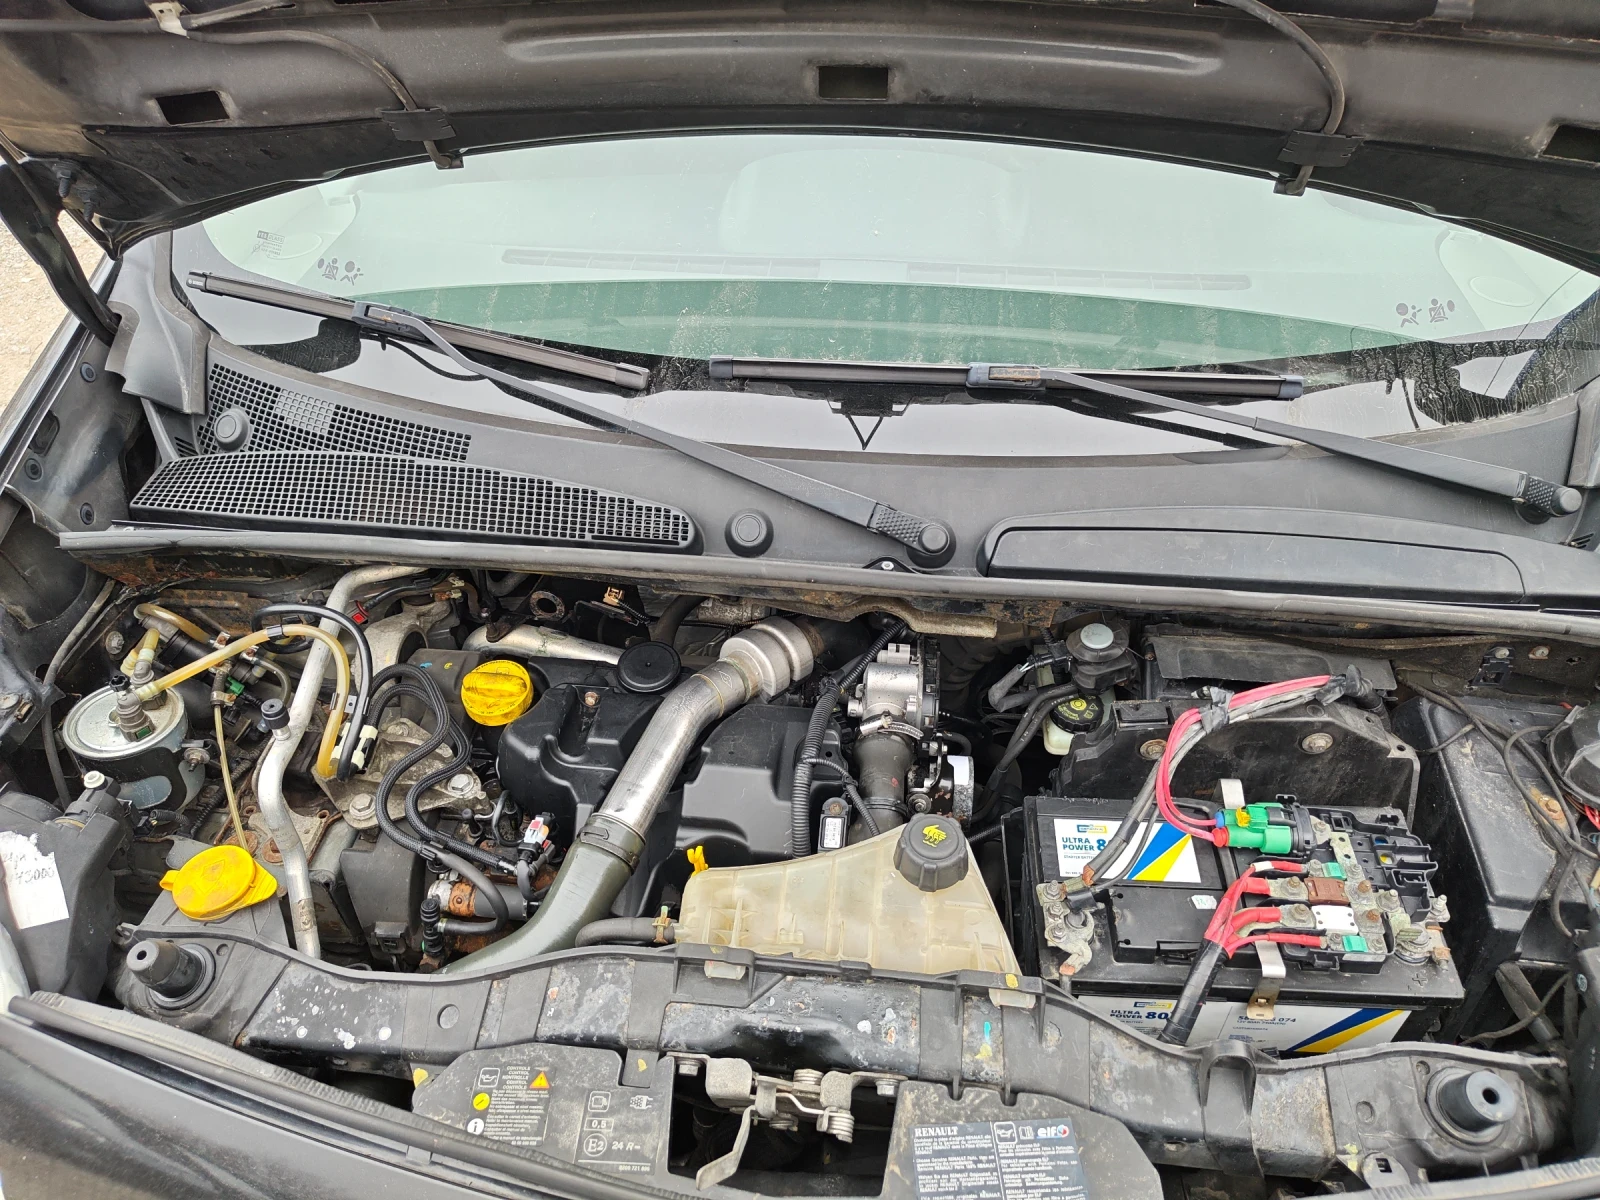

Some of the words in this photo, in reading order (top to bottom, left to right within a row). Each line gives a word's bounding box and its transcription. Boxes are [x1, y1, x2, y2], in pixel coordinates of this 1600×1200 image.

[1062, 837, 1091, 845] ULTRA
[1145, 1011, 1170, 1020] 80
[591, 1119, 607, 1129] 0,5
[914, 1126, 958, 1137] RENAULT
[1037, 1126, 1057, 1137] elf
[587, 1138, 604, 1152] E2
[611, 1140, 624, 1150] 24
